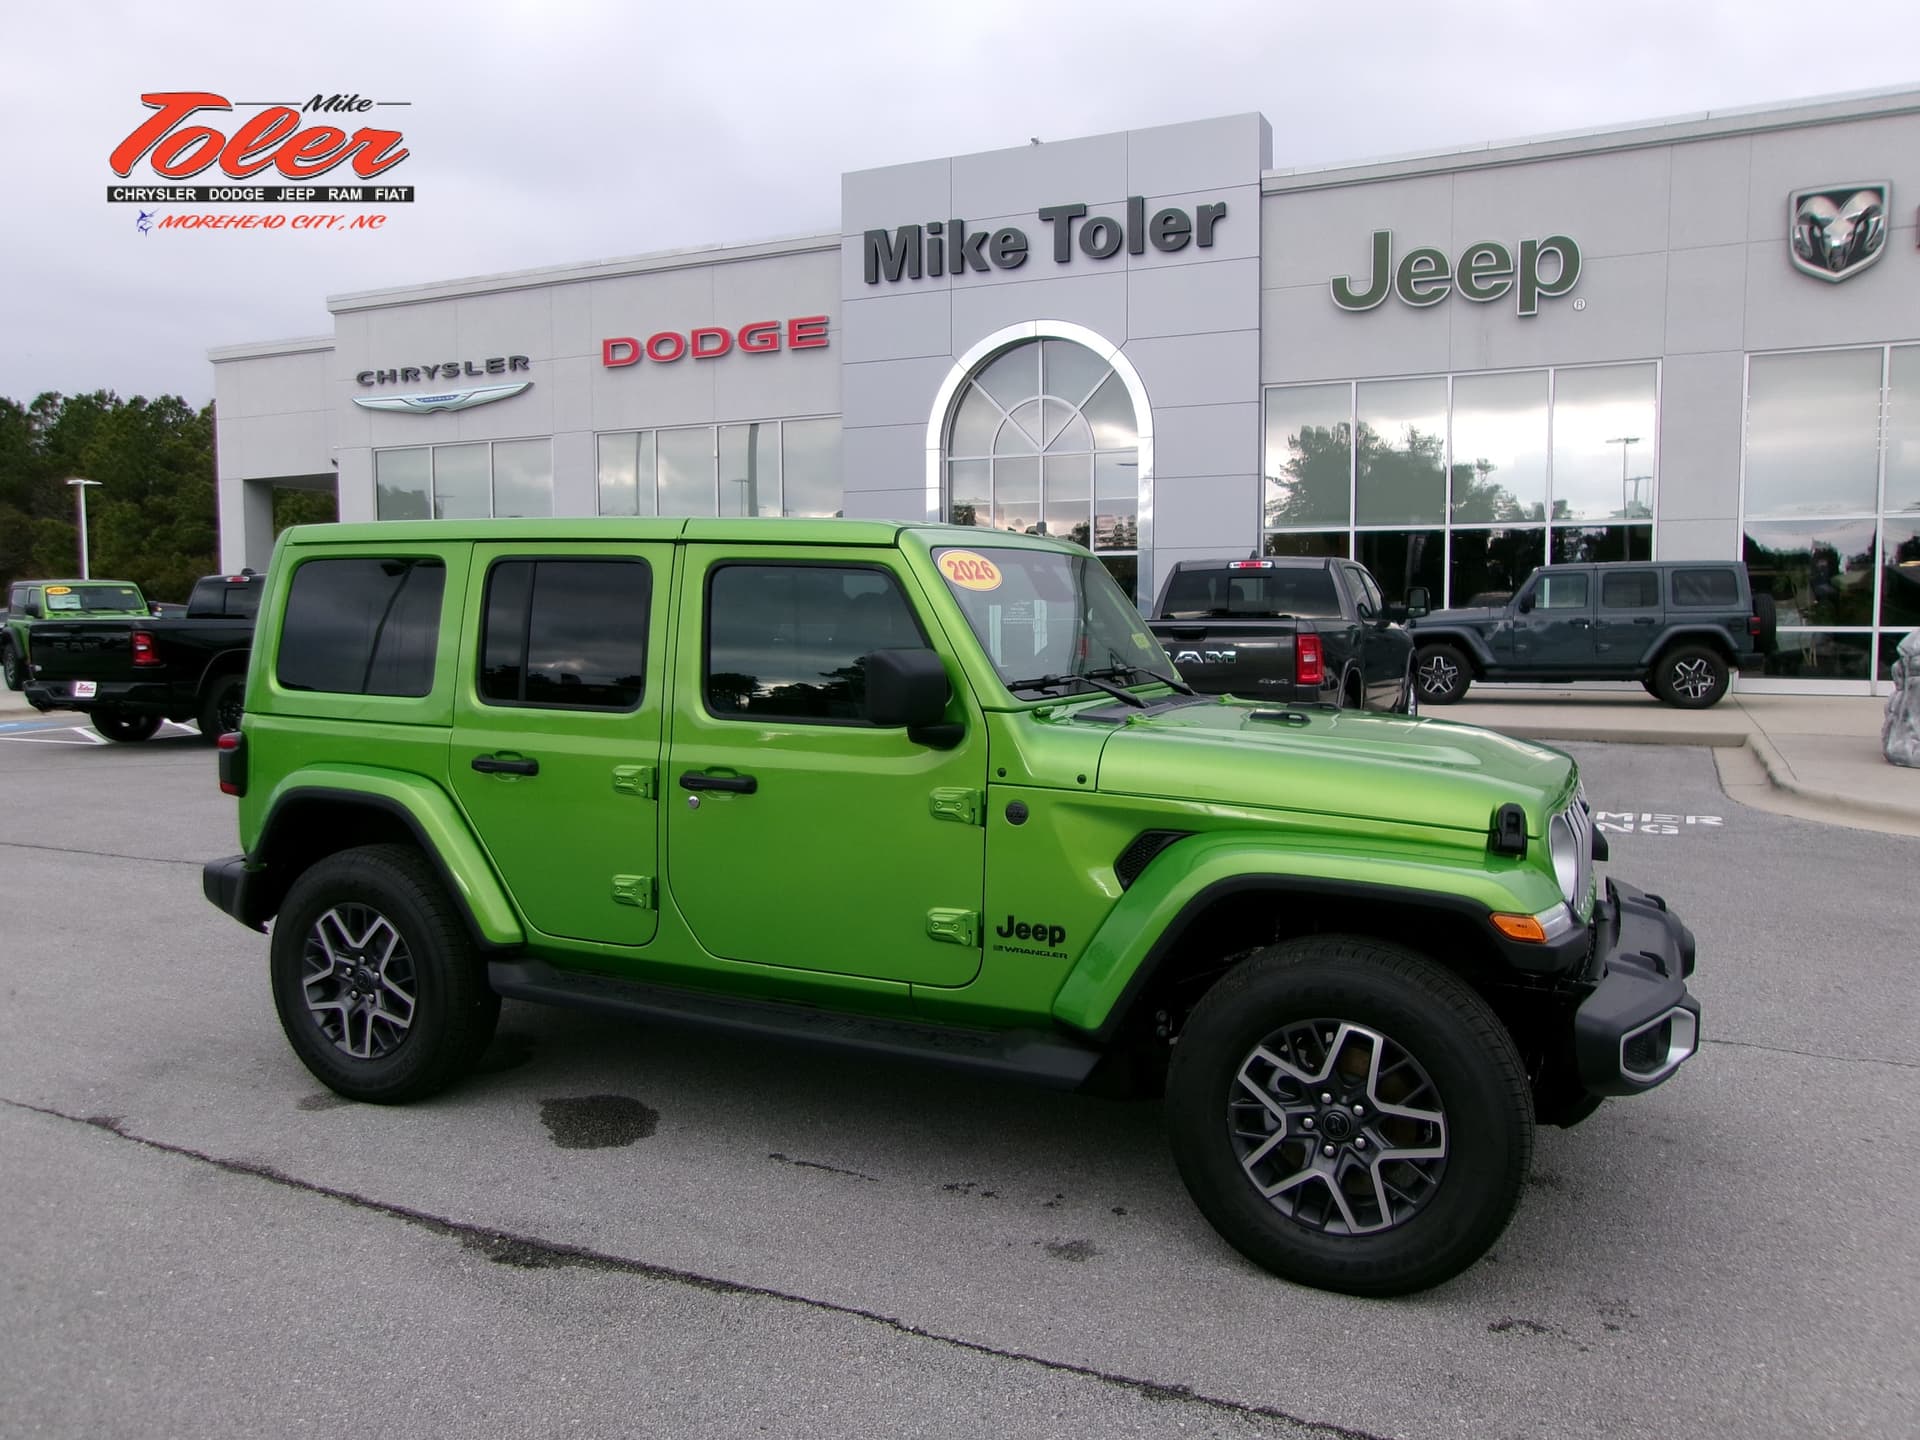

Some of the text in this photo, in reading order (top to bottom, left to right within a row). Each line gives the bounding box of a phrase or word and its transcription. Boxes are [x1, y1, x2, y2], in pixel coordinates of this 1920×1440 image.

[864, 195, 1226, 284] Mike Toler
[1329, 228, 1583, 317] Jeep
[601, 315, 831, 369] DODGE
[356, 354, 531, 388] CHRYSLER
[946, 559, 996, 582] 2026
[996, 914, 1067, 948] Jeep
[1004, 945, 1069, 960] WRANGLER
